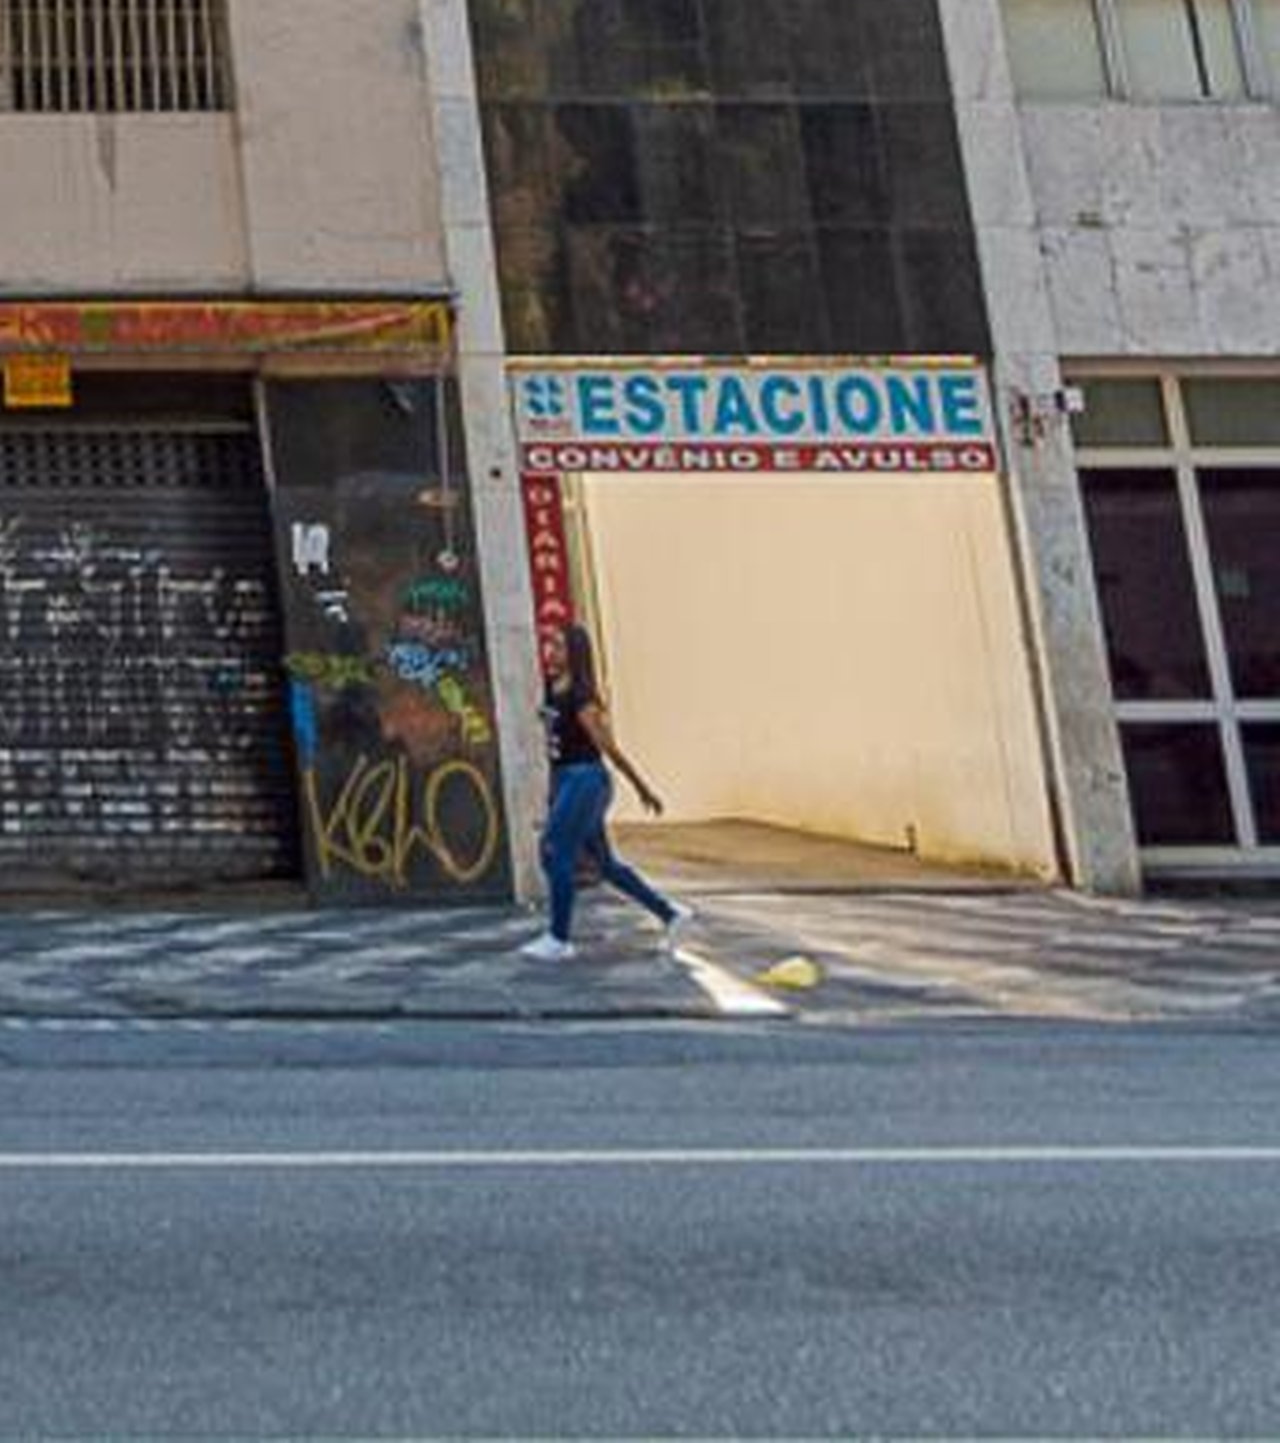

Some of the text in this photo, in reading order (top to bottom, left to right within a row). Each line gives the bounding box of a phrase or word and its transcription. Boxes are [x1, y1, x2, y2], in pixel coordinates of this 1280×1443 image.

[578, 374, 982, 435] ESTACIONE
[774, 450, 800, 469] E
[814, 450, 989, 470] AVULSO
